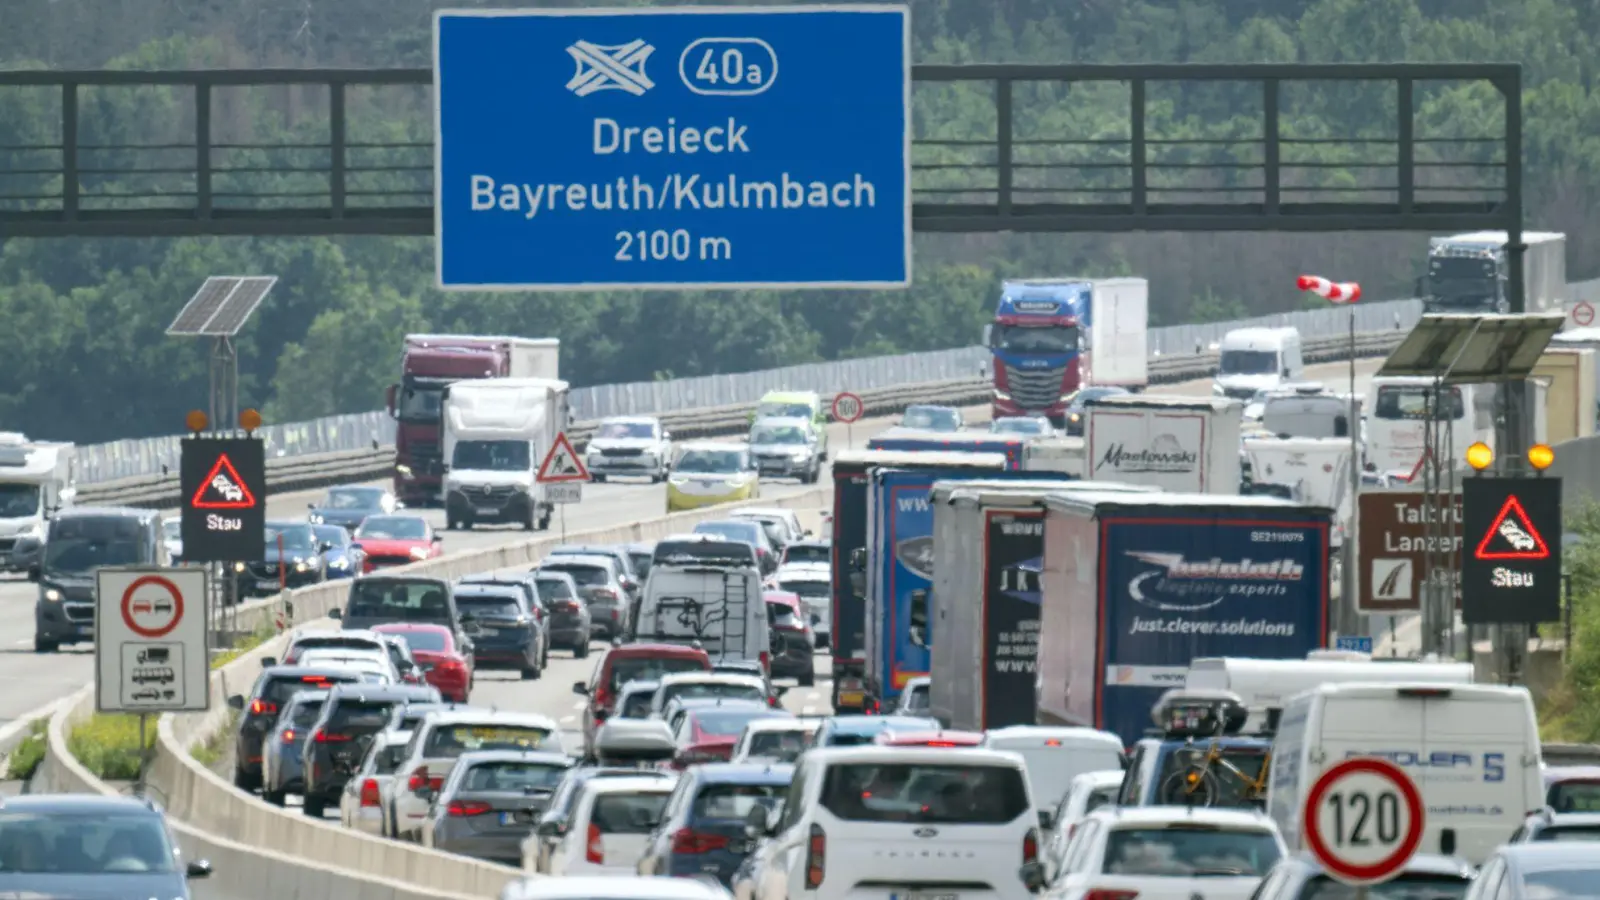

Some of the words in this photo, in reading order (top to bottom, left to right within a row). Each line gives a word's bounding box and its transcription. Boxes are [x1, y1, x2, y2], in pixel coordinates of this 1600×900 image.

[695, 48, 762, 85] 40a
[592, 118, 750, 155] Dreieck
[470, 174, 876, 219] Bayreuth/Kulmbach
[614, 230, 691, 261] 2100
[699, 236, 732, 260] m
[206, 513, 242, 530] Stau
[1228, 581, 1287, 598] experts
[1491, 567, 1534, 588] Stau
[1129, 616, 1296, 636] just.clever.solutions
[1328, 791, 1398, 848] 120
